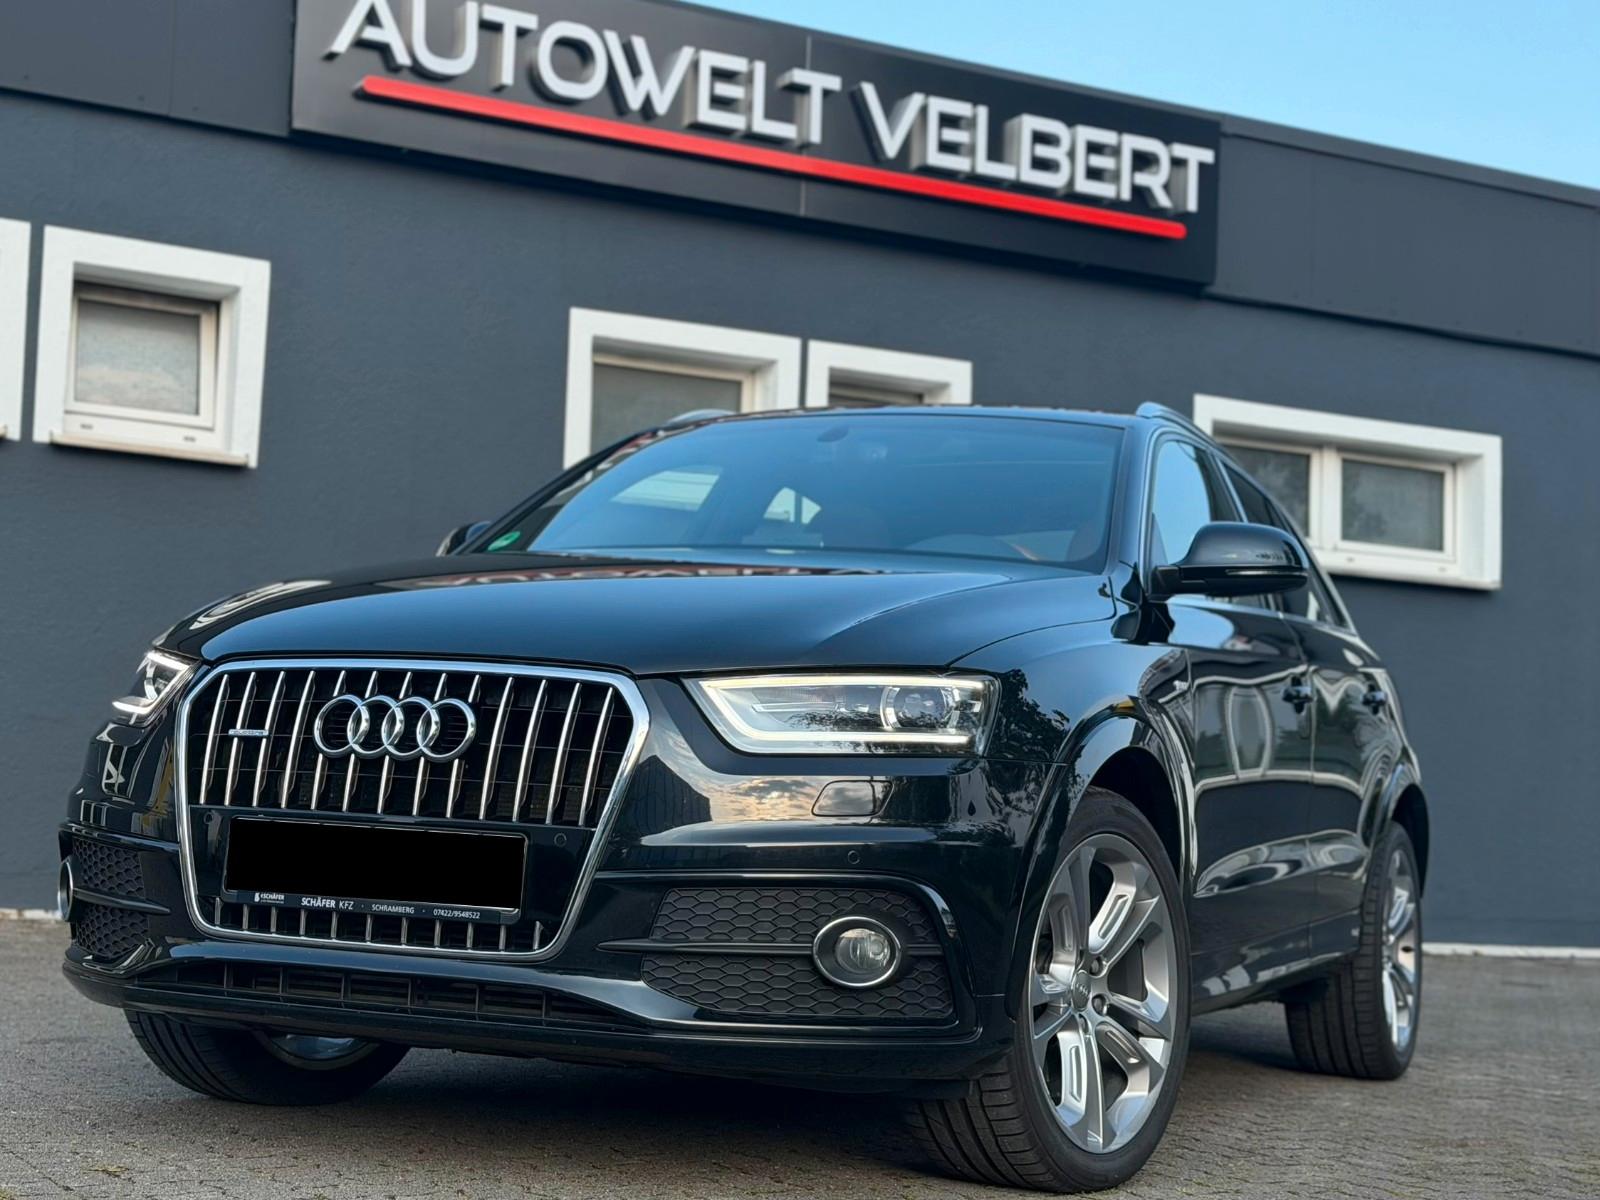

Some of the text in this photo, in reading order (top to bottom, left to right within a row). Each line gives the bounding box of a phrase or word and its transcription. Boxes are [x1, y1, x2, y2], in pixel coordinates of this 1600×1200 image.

[328, 0, 1215, 214] AUTOWELT VELBERT
[301, 897, 336, 909] SCHÄFER
[339, 901, 354, 910] KFZ
[371, 903, 415, 914] SCHRAMBERG
